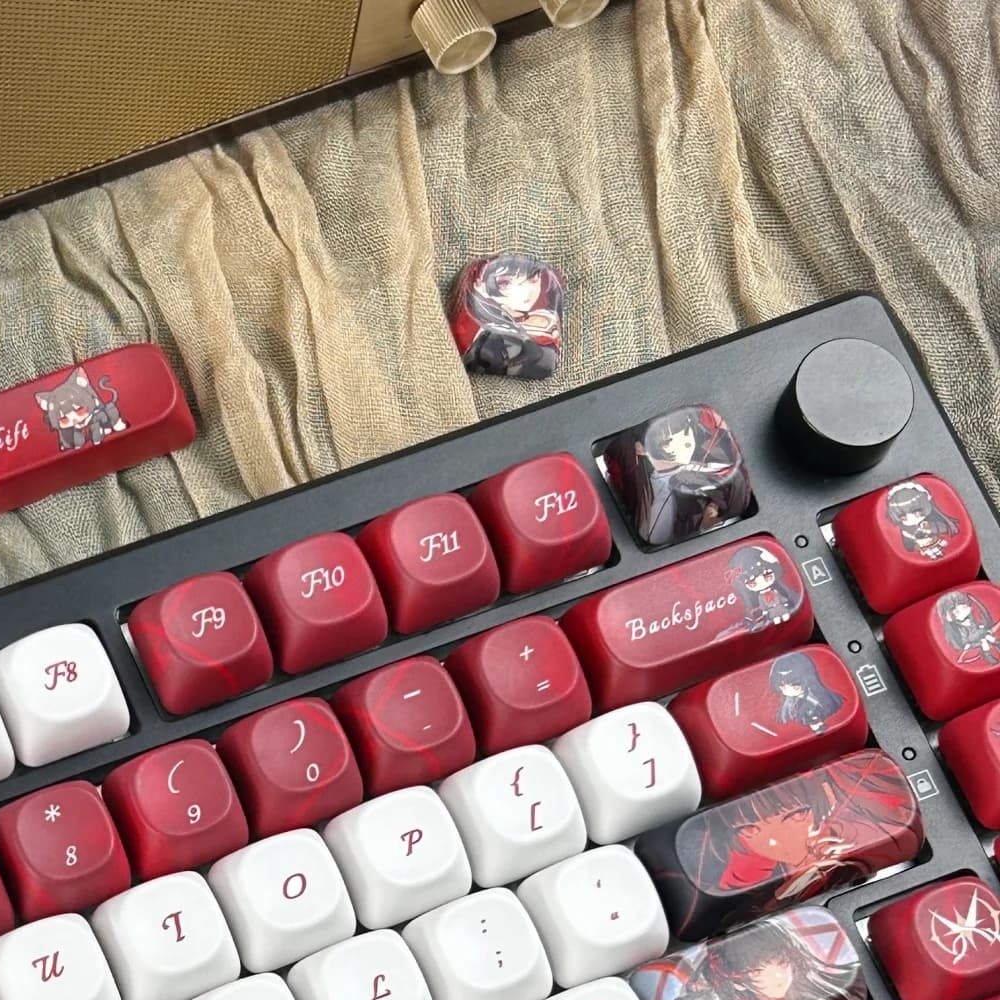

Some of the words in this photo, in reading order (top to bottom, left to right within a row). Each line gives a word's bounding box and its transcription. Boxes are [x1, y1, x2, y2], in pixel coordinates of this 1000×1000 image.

[534, 490, 578, 523] F12
[419, 530, 461, 563] F11
[300, 565, 345, 599] F10
[810, 564, 827, 581] A
[191, 606, 226, 638] F9
[624, 592, 738, 642] Backspace
[519, 645, 534, 661] +
[44, 660, 78, 691] F8
[536, 679, 550, 692] =
[290, 719, 306, 754] )
[167, 760, 184, 794] (
[642, 757, 656, 789] ]
[187, 804, 201, 825] 9
[530, 801, 543, 832] [
[65, 845, 78, 867] 8
[400, 828, 423, 857] P
[282, 872, 307, 900] O
[31, 950, 65, 983] U
